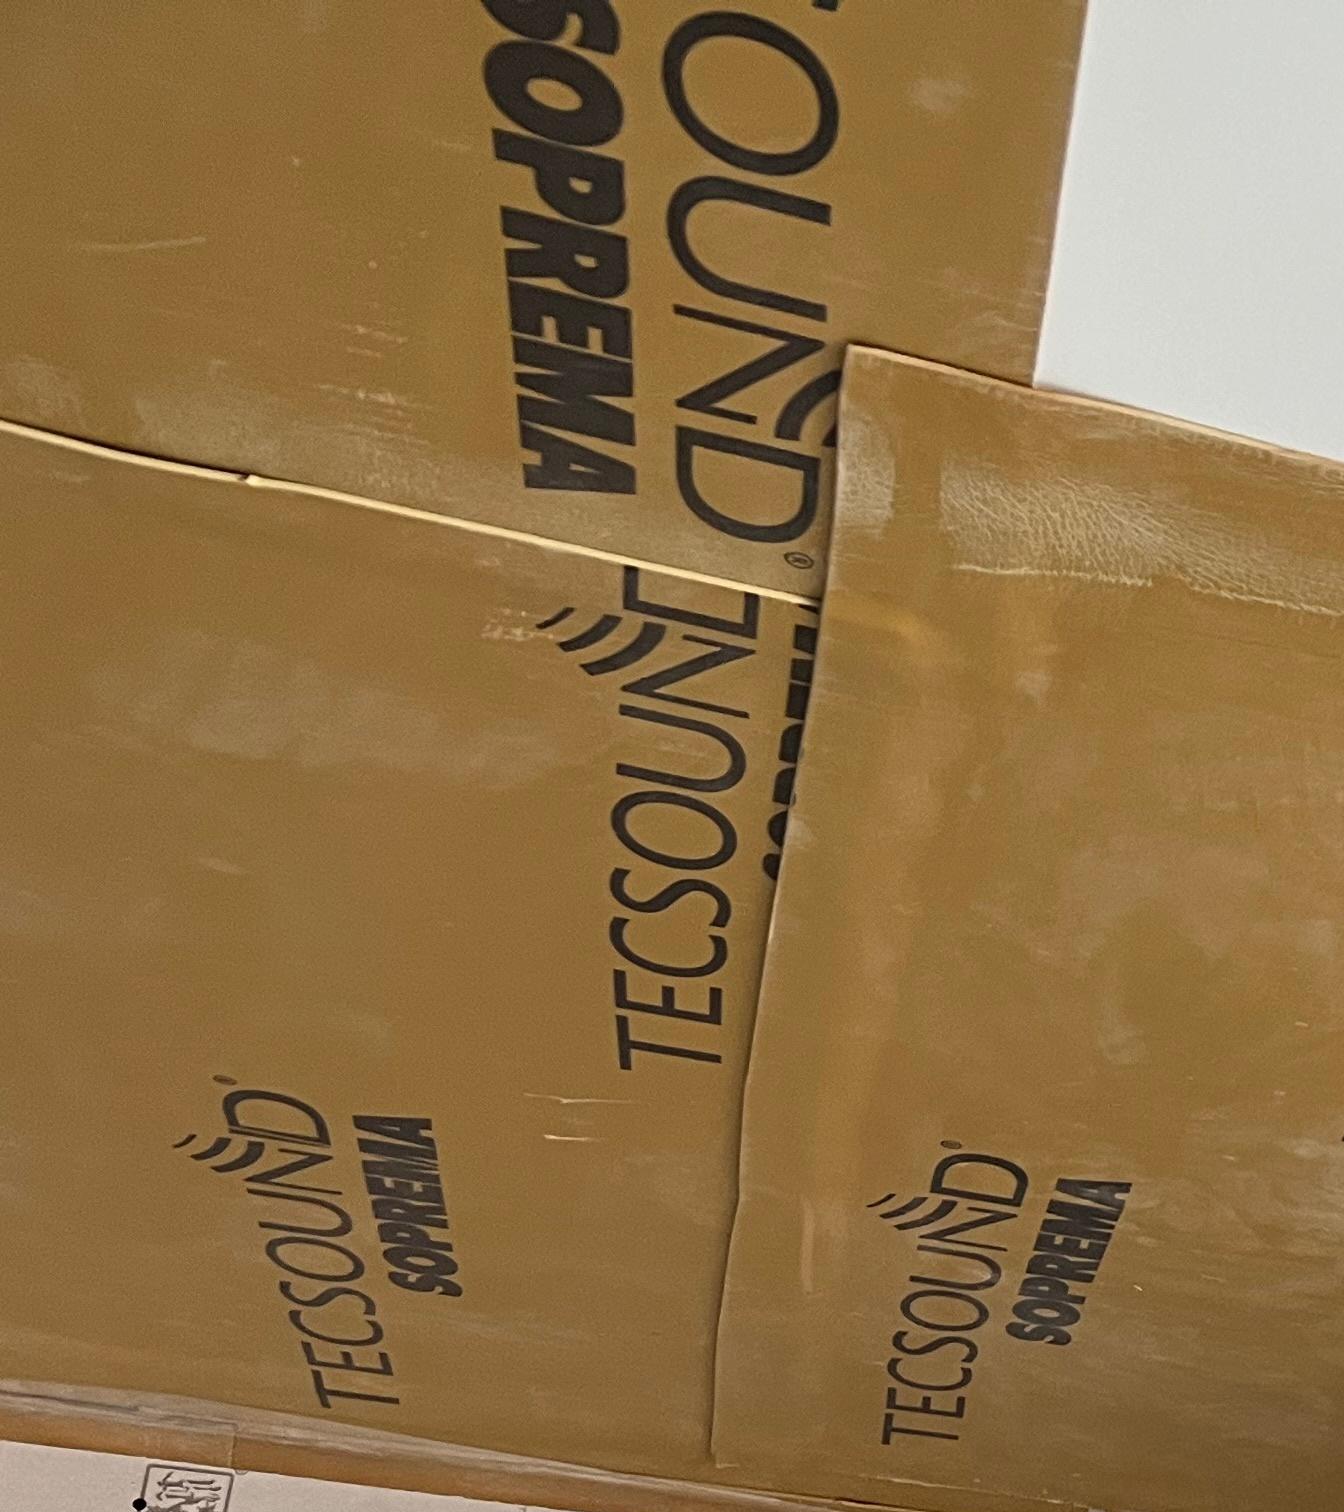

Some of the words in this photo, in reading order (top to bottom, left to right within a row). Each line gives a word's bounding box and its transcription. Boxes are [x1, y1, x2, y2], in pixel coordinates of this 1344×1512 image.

[661, 0, 840, 544] OUND
[222, 1087, 400, 1409] TECSOUND
[352, 1114, 464, 1297] SOPREMA
[881, 1152, 1030, 1447] TECSOUND
[1004, 1177, 1133, 1346] SOPREMA
